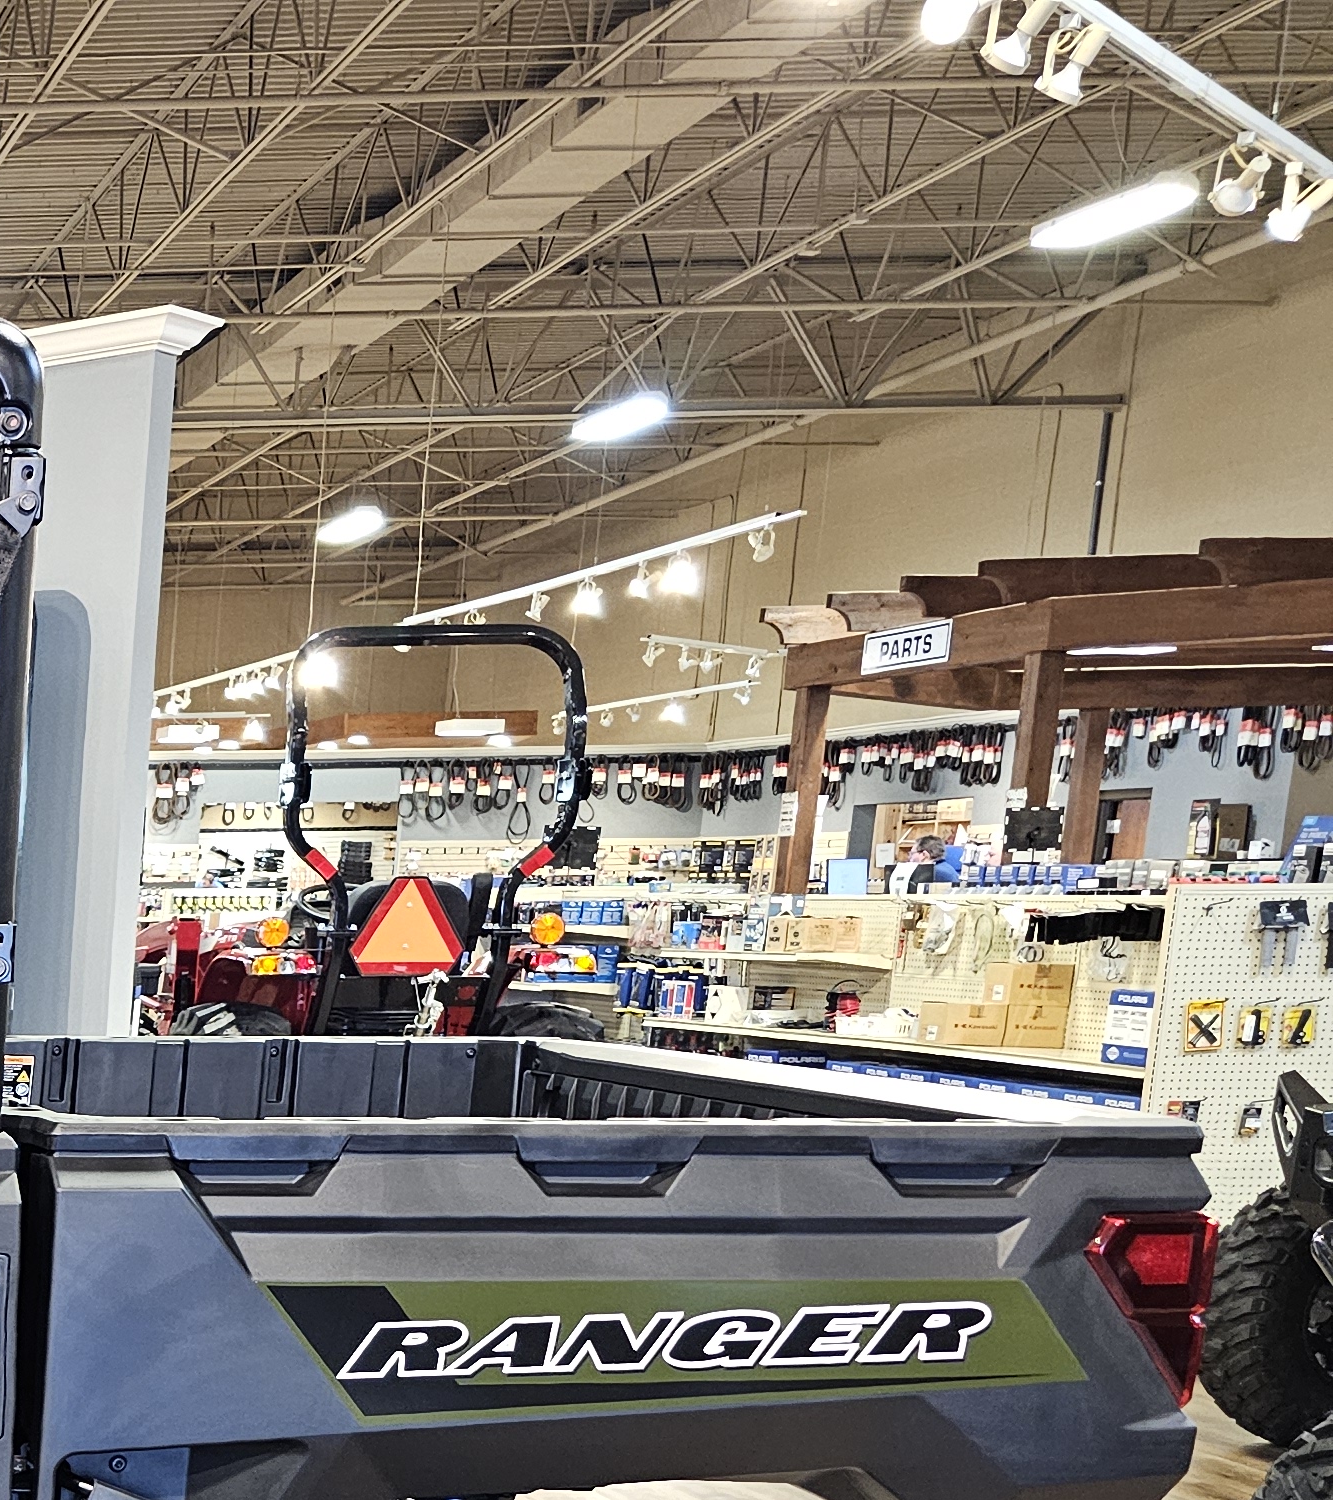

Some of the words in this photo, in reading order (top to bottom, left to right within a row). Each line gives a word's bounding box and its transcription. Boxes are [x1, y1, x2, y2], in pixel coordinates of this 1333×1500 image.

[879, 633, 933, 662] PARTS
[1118, 994, 1149, 1005] POLARIS
[748, 1054, 773, 1063] POLARIS
[779, 1056, 826, 1064] POLARIS
[831, 1064, 853, 1073] POLARIS
[866, 1068, 889, 1078] POLARIS
[900, 1072, 924, 1082] POLARIS
[939, 1077, 966, 1088] POLARIS
[979, 1083, 1006, 1093] POLARIS
[1021, 1088, 1049, 1098] POLARIS
[1064, 1093, 1094, 1104] POLARIS
[1104, 1099, 1136, 1110] POLARIS
[336, 1301, 994, 1380] RANGER
